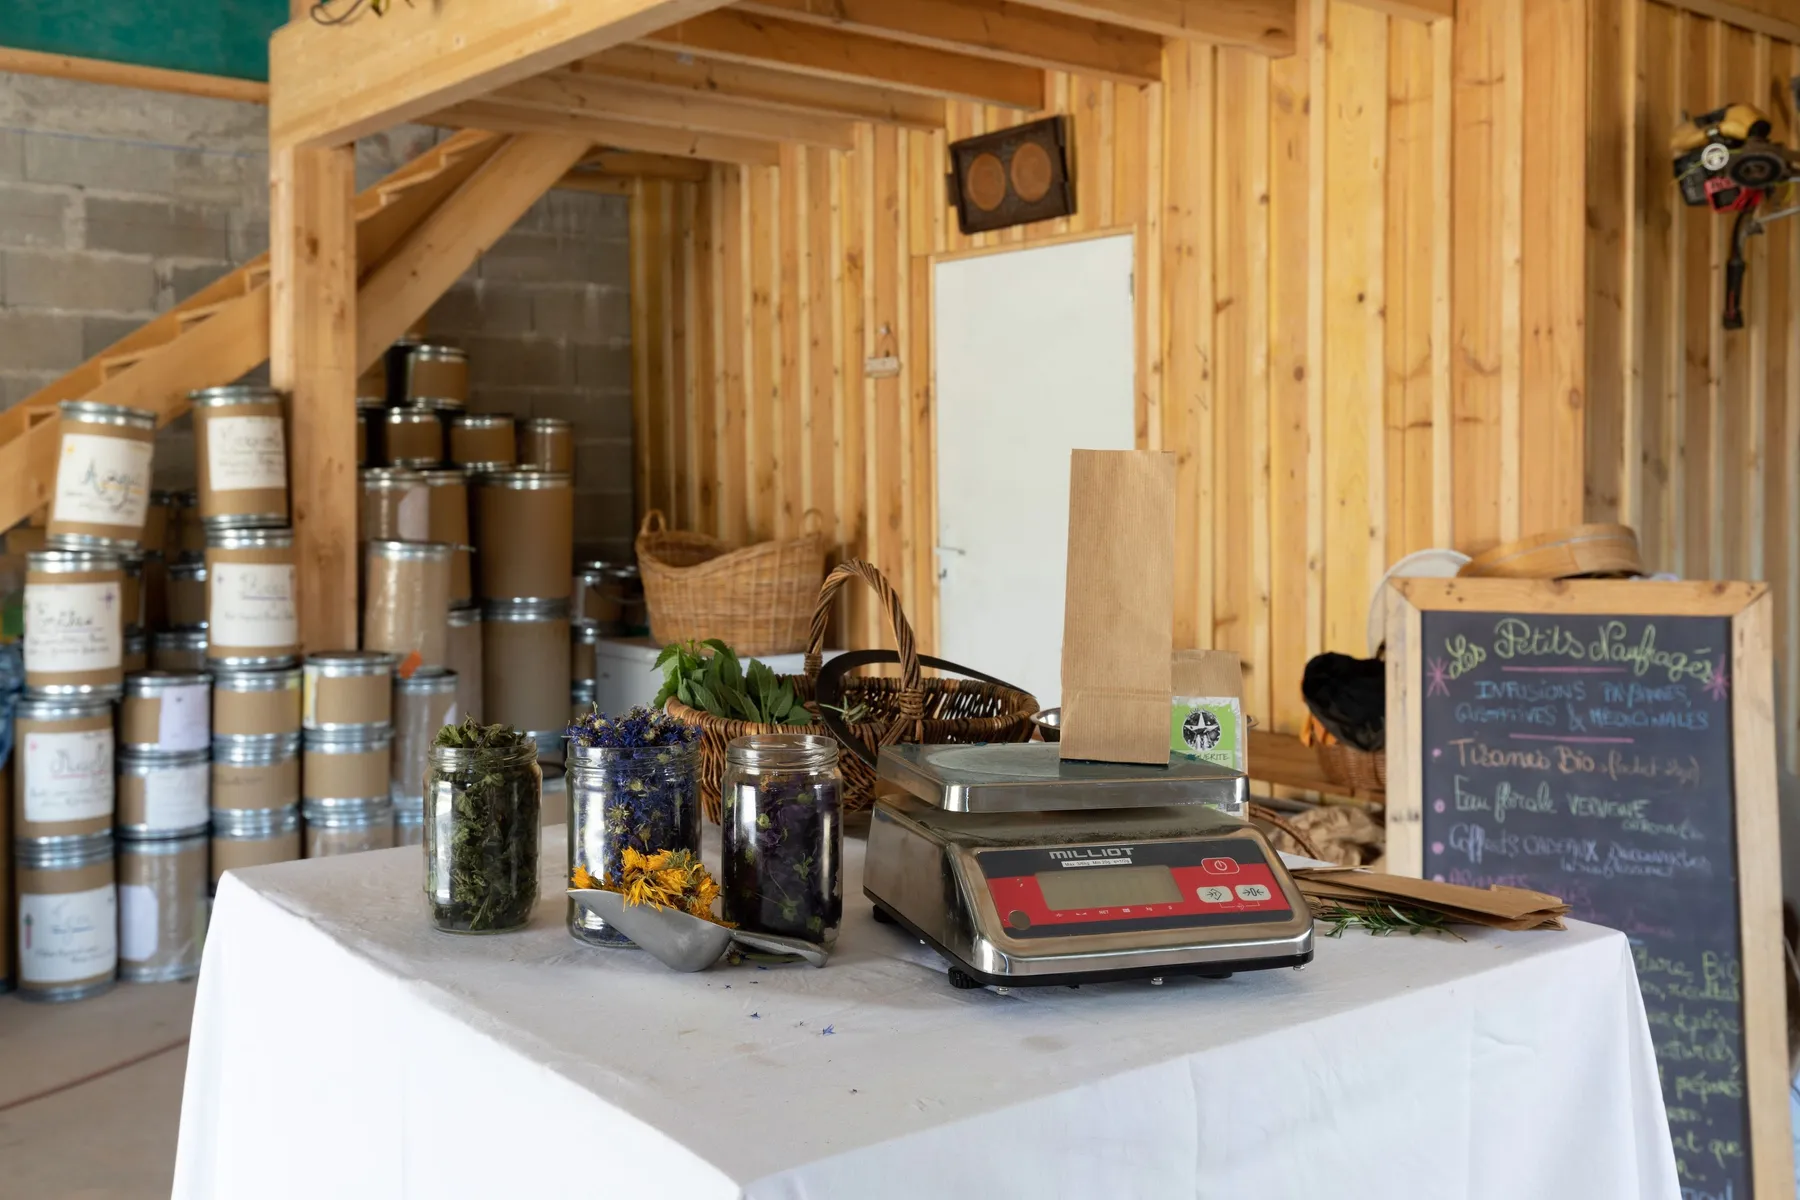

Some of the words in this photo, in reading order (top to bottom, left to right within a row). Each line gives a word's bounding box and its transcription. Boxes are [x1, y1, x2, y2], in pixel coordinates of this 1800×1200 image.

[1446, 634, 1487, 680] Les
[1494, 617, 1586, 660] Petits
[1449, 739, 1551, 769] Tisanes
[1553, 744, 1596, 774] Bio
[1453, 774, 1492, 812] Eau
[1493, 781, 1558, 823] florale
[1049, 847, 1134, 860] MILLIOT
